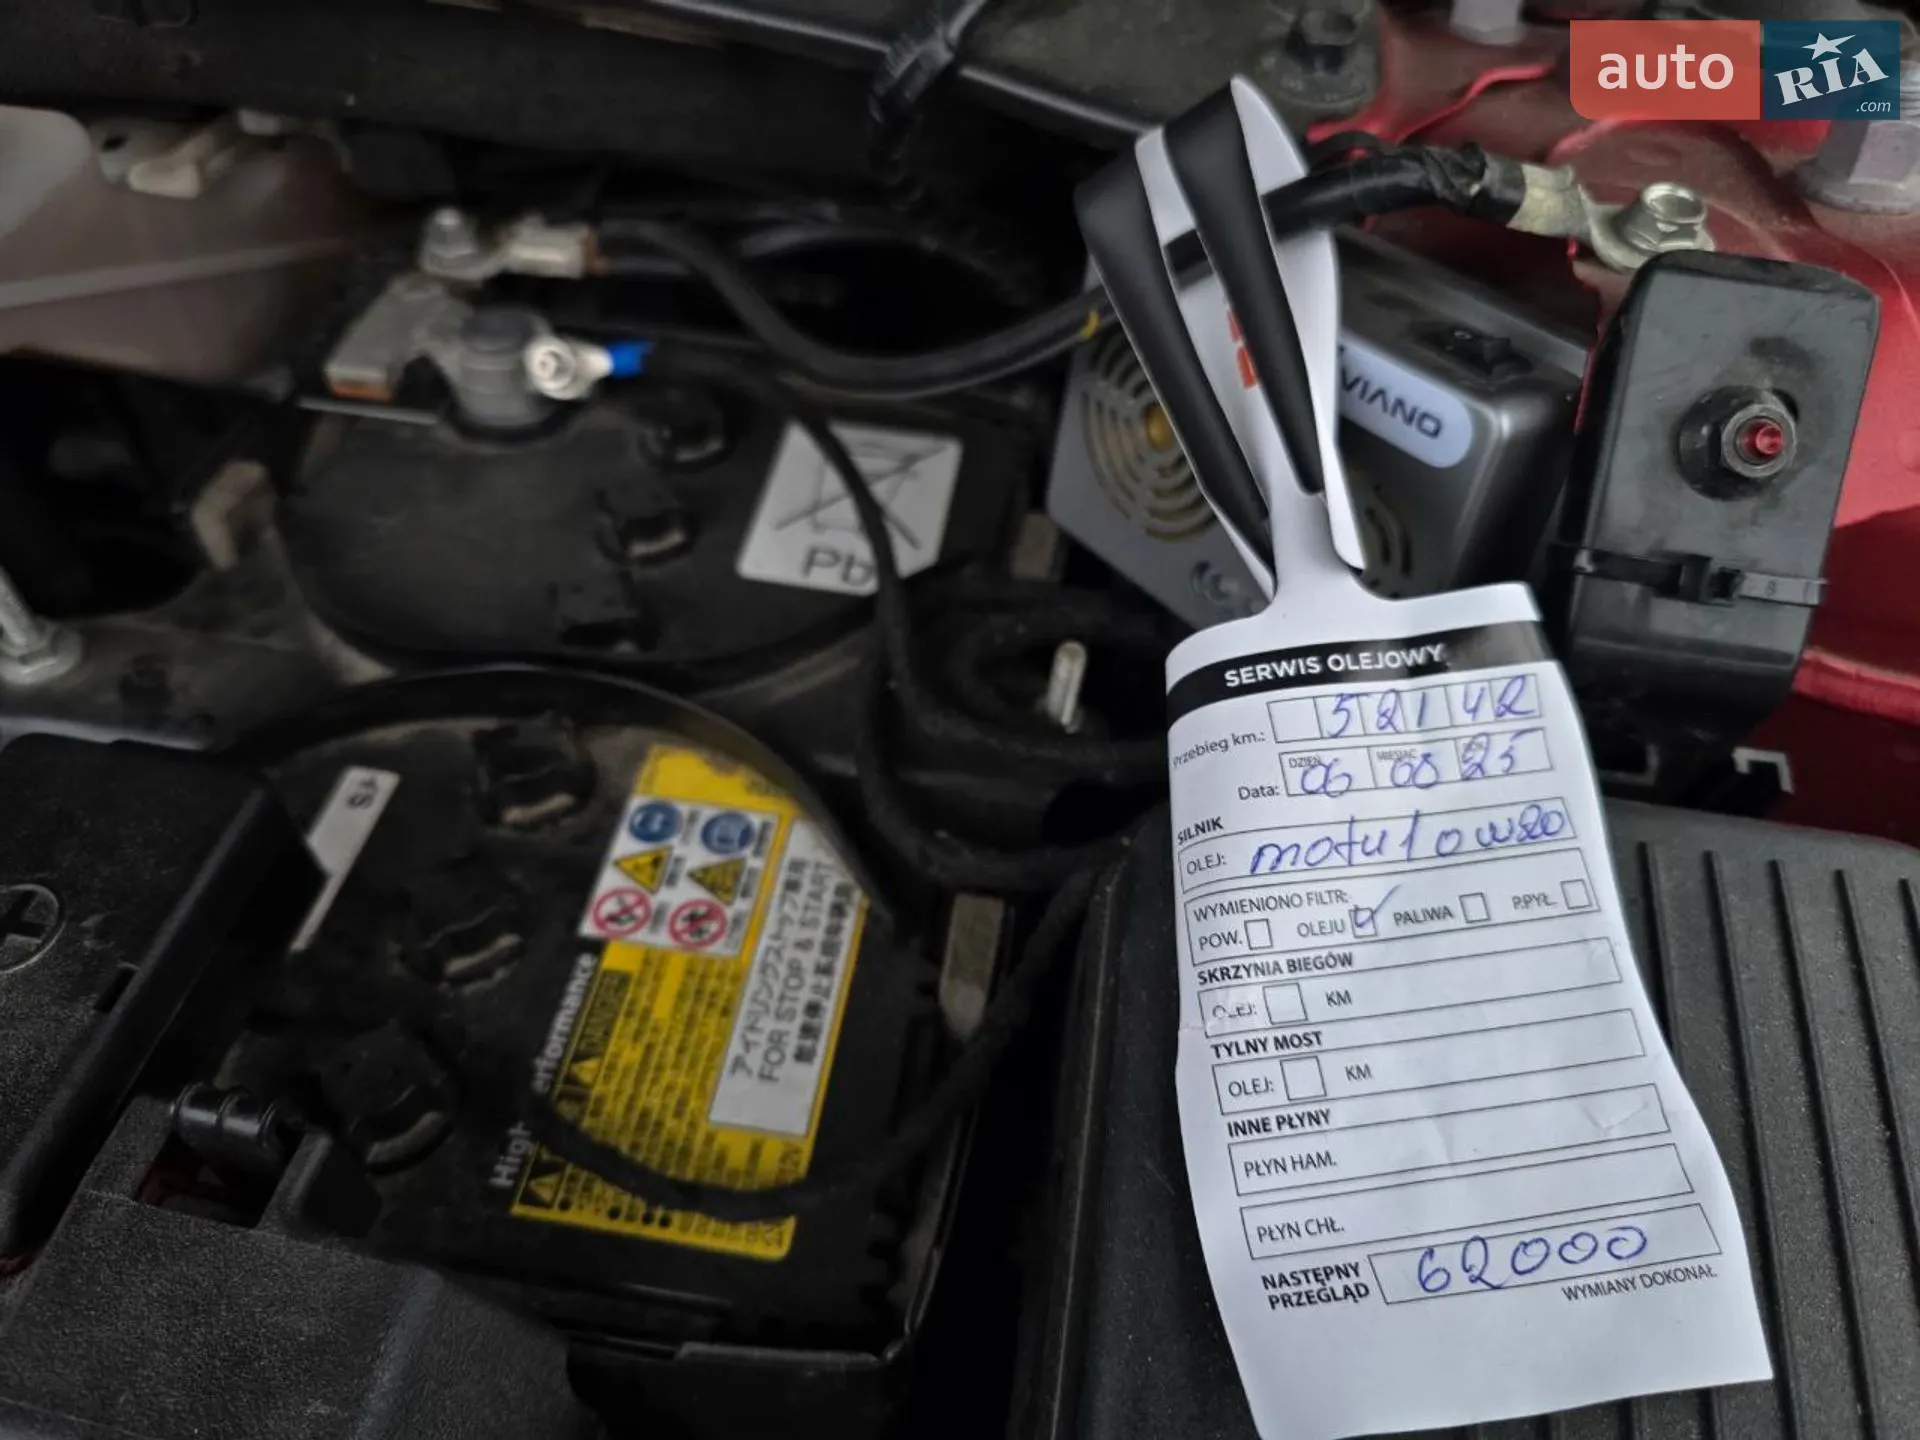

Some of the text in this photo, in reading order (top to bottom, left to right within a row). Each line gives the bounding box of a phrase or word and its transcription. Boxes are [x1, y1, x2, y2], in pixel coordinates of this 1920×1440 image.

[803, 545, 875, 586] Pb
[1225, 643, 1445, 688] SERWIS OLEJOWY
[1237, 783, 1280, 801] Data:
[1177, 816, 1224, 845] SILNIK
[1186, 853, 1227, 875] OLEJ:
[800, 859, 838, 930] START
[1193, 892, 1302, 922] WYMIENIONO
[1297, 919, 1345, 938] OLEJU
[1393, 907, 1454, 927] PALIWA
[1198, 930, 1243, 951] POW.
[1197, 951, 1354, 985] SKRZYNIA BIEGÓW
[774, 957, 806, 1024] STOP
[1325, 990, 1353, 1007] KM
[529, 952, 598, 1094] erformance
[757, 1028, 792, 1083] FOR
[1211, 1031, 1323, 1060] TYLNY MOST
[1344, 1063, 1373, 1081] KM
[1228, 1077, 1274, 1097] OLEJ:
[1227, 1108, 1332, 1138] INNE PŁYNY
[1243, 1150, 1338, 1178] PŁYN HAM.
[1256, 1216, 1345, 1243] PŁYN CHŁ.
[1417, 1224, 1648, 1293] 62000
[1261, 1261, 1361, 1291] NASTĘPNY
[1562, 1277, 1637, 1301] WYMIANY
[1268, 1281, 1370, 1311] PRZEGLĄD
